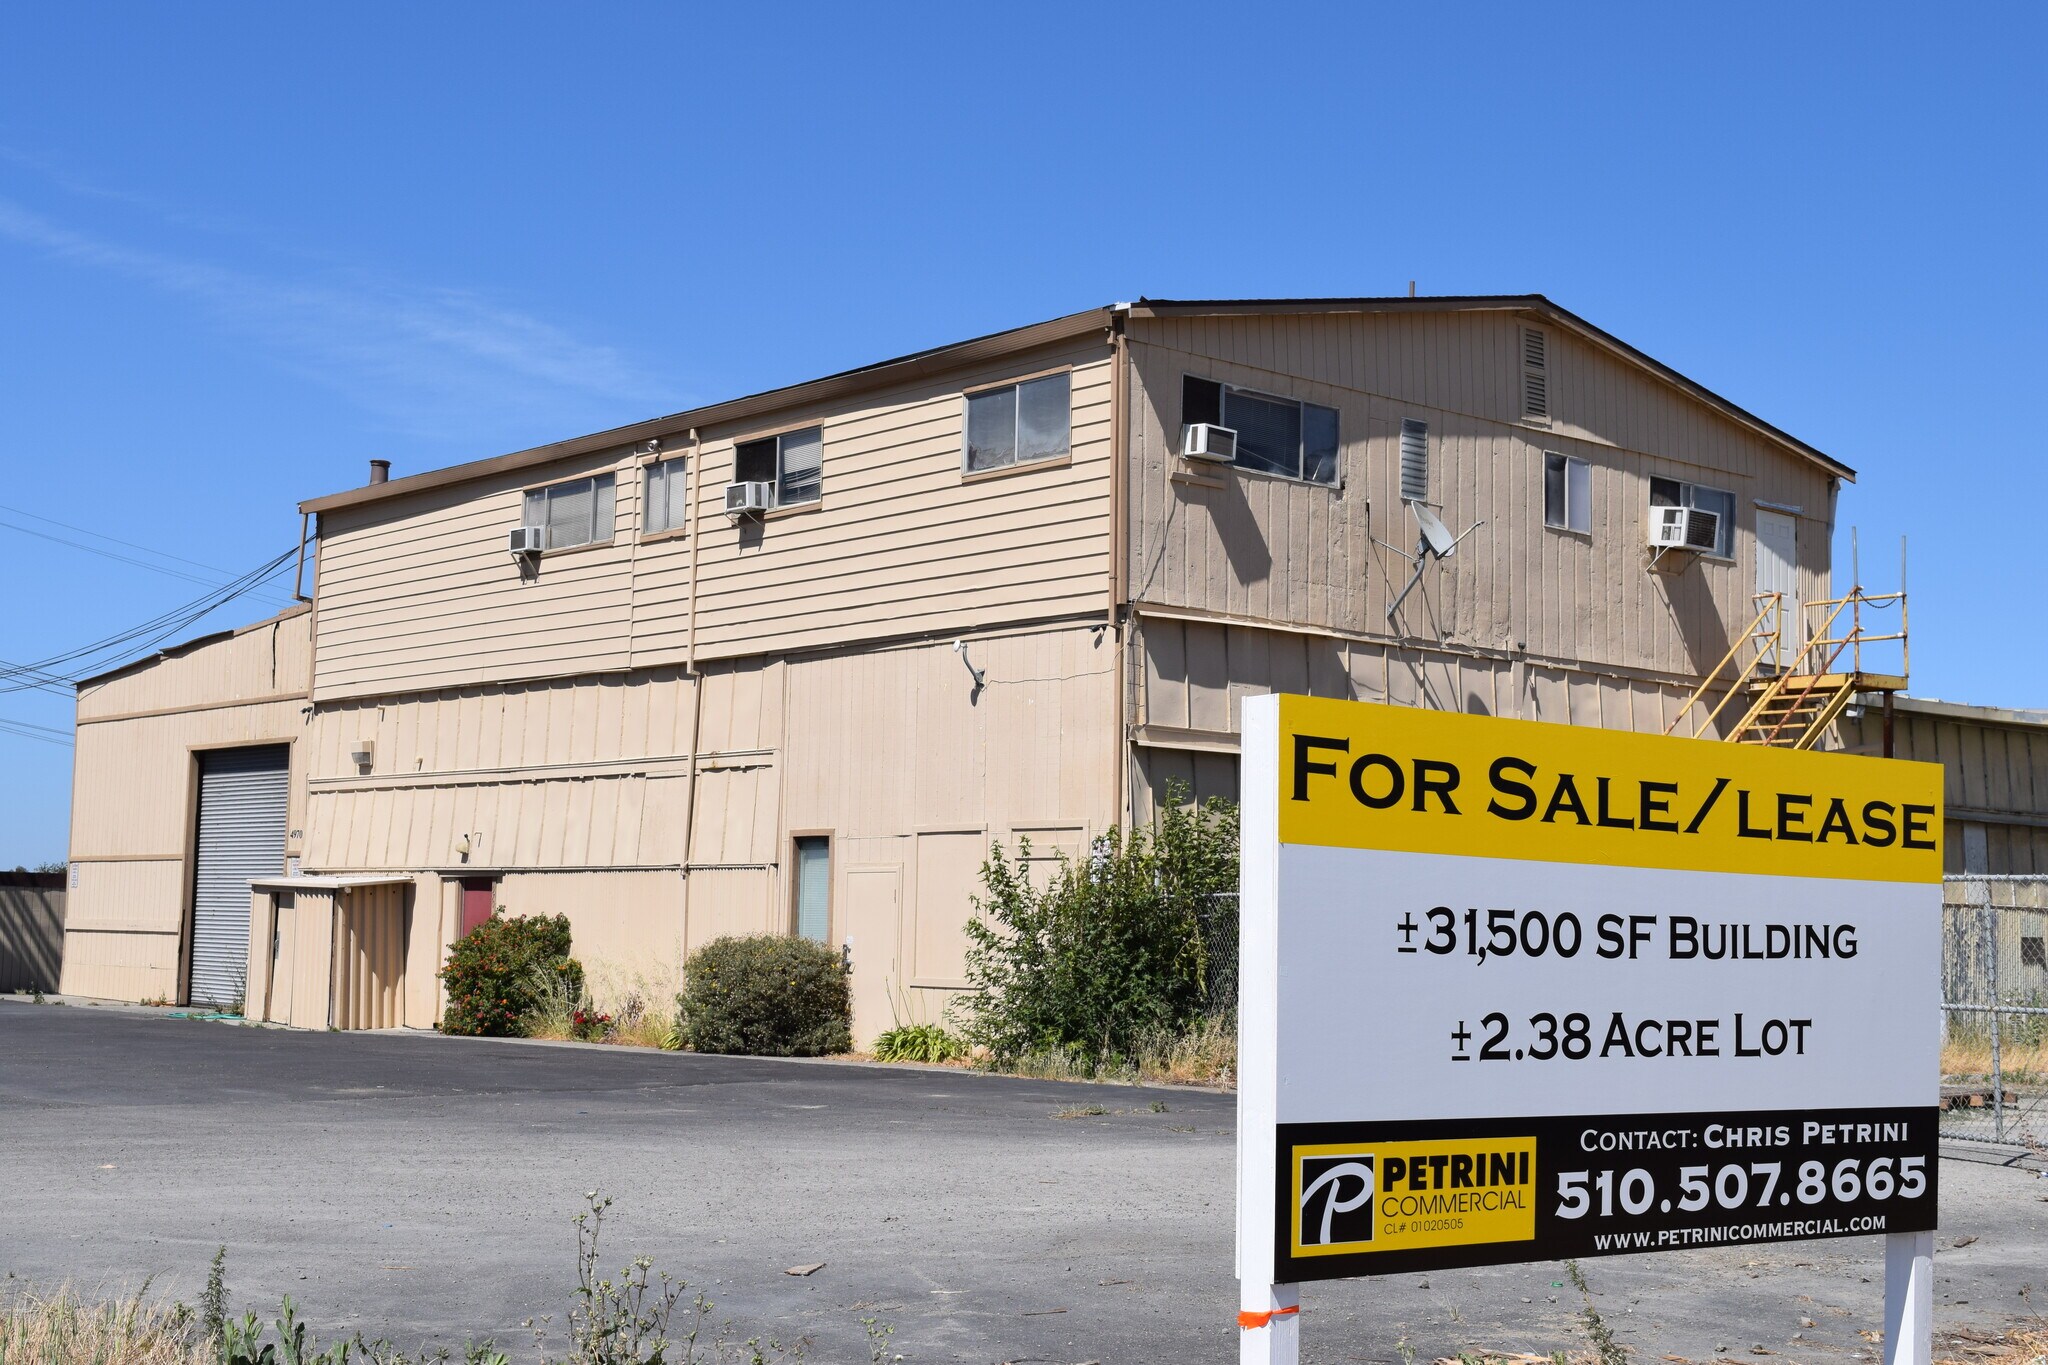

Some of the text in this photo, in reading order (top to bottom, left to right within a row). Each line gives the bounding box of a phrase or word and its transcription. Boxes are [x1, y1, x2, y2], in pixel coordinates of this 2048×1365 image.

[1291, 734, 1937, 853] FOR SALE/LEASE
[1596, 913, 1657, 960] SF
[1668, 915, 1859, 961] BUILDING
[1451, 1012, 1813, 1062] ±2.38 ACRE LOT
[1580, 1121, 1908, 1152] CONTACT: CHRIS PETRINI
[1383, 1151, 1529, 1192] PETRINI
[1555, 1155, 1927, 1220] 510.507.8665
[1382, 1190, 1527, 1218] COMMERCIAL
[1384, 1218, 1464, 1235] CL# 01020505
[1594, 1215, 1886, 1251] WWW.PETRINICOMMERCIAL.COM
